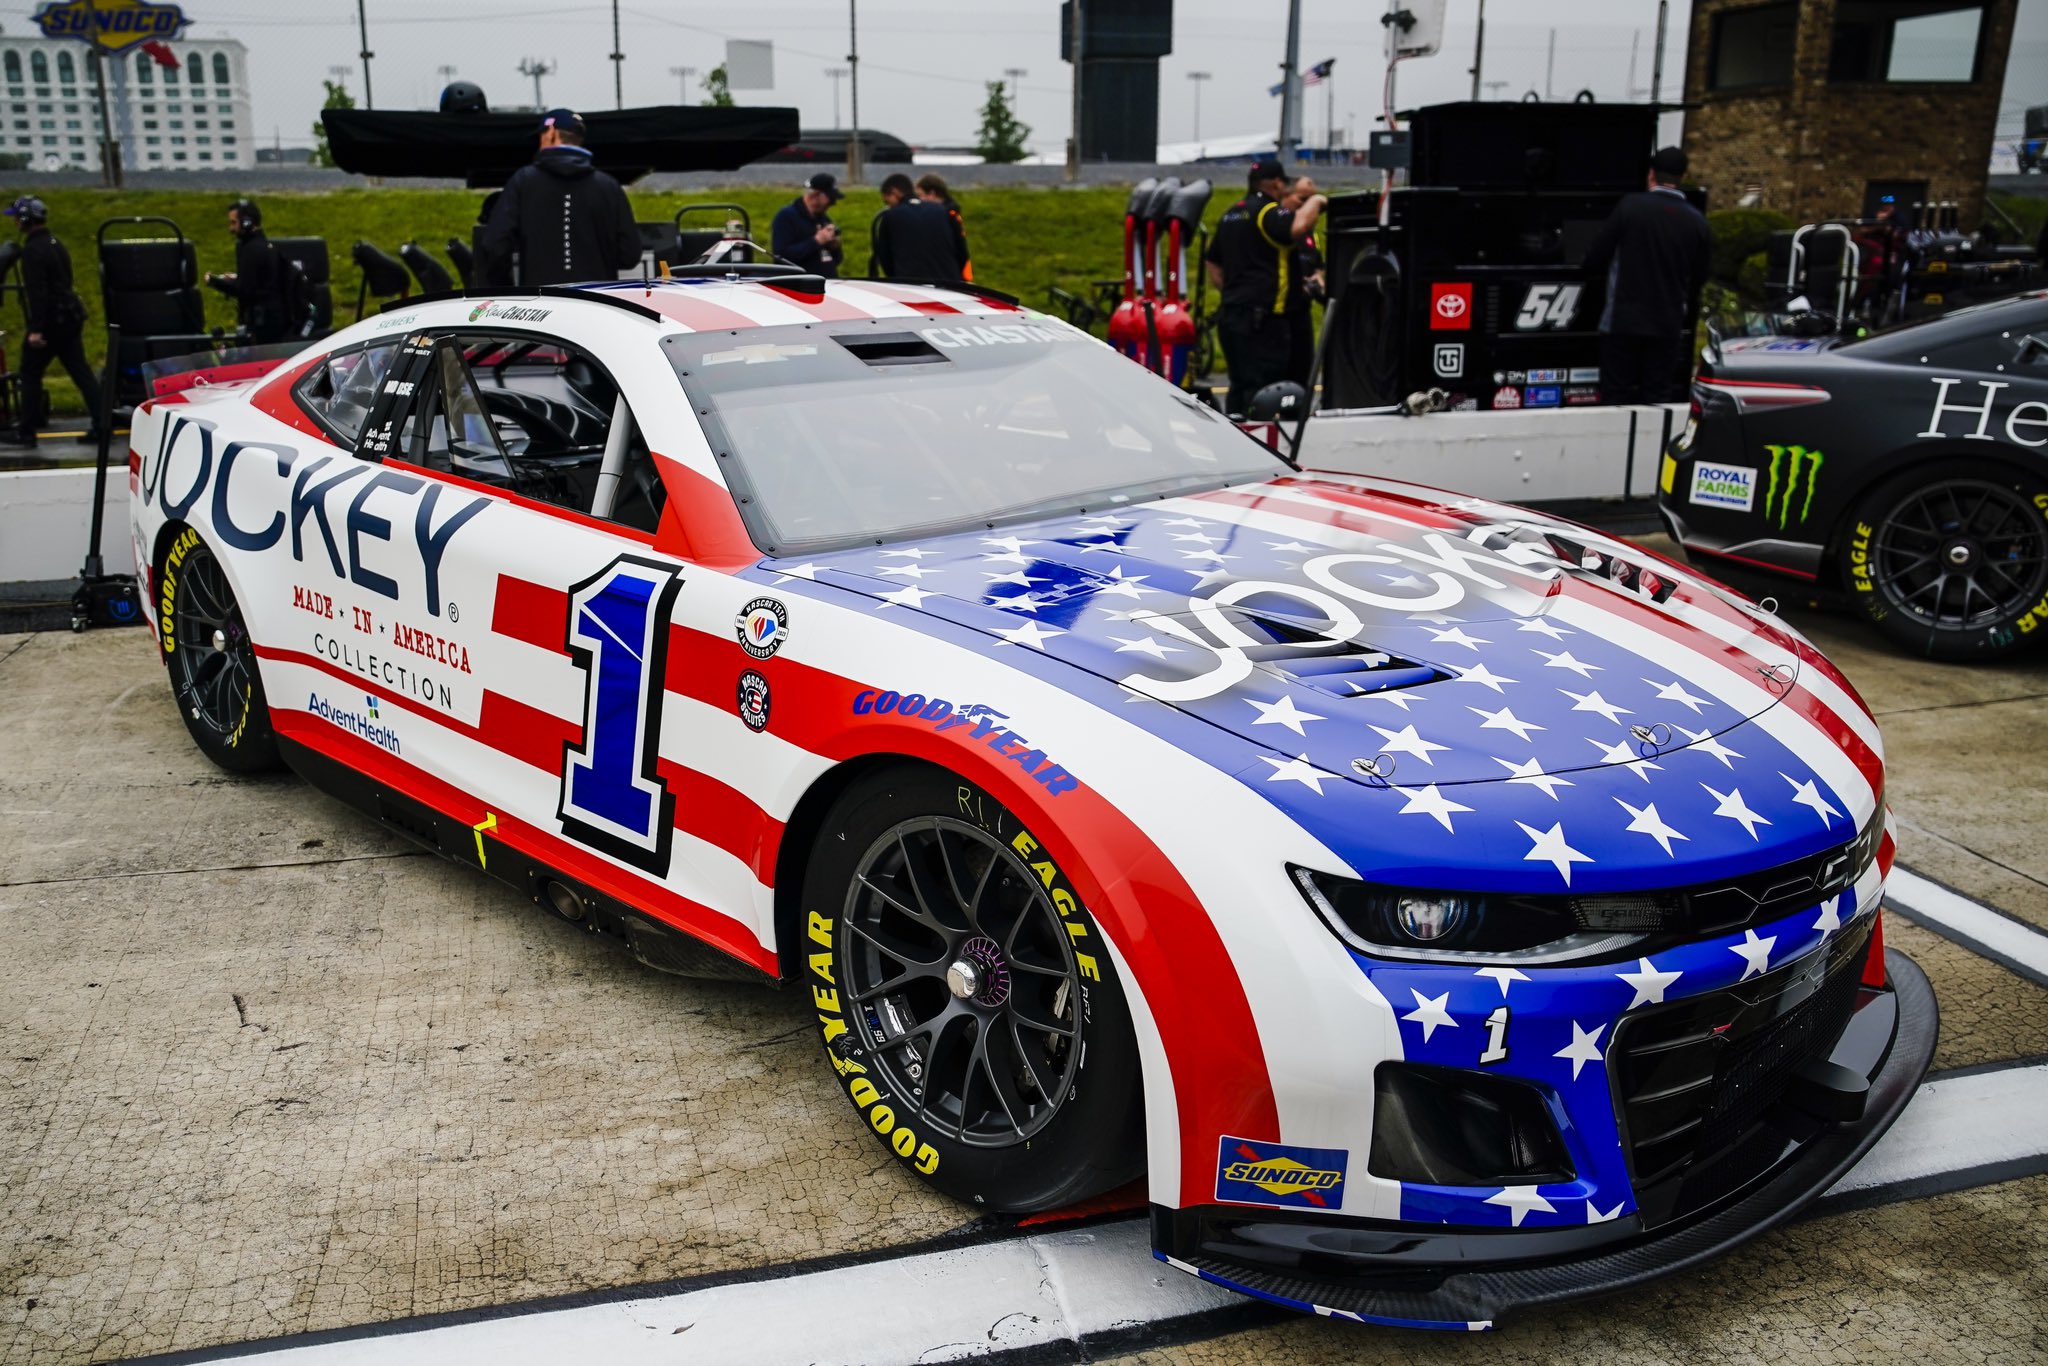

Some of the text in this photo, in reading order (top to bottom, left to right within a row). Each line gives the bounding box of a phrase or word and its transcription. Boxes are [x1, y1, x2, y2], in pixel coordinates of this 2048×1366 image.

[50, 9, 174, 32] SUNOCO
[376, 314, 418, 331] SIEMENS
[501, 305, 553, 323] CHASTAIN
[1516, 284, 1582, 329] 54
[1696, 480, 1748, 498] FARMS
[1698, 467, 1749, 485] ROYAL
[143, 411, 494, 618] JOCKEY
[1851, 521, 1872, 592] EAGLE
[162, 527, 200, 653] GOODYEAR
[746, 599, 787, 623] NASCAR 75TH
[1118, 535, 1580, 702] JOCK
[293, 585, 472, 675] MADE IN AMERICA
[739, 631, 779, 658] ANNIVERSARY
[314, 633, 453, 710] COLLECTION
[742, 674, 768, 699] NASCAR
[308, 692, 401, 755] AdventHealth
[556, 552, 686, 881] 1
[740, 702, 767, 727] SALUTES
[852, 690, 1079, 798] GOODYEAR
[1012, 830, 1101, 982] EAGLE
[808, 910, 940, 1175] GOODYEAR
[1480, 1006, 1508, 1063] 1
[1229, 1164, 1338, 1187] SUNOCO
